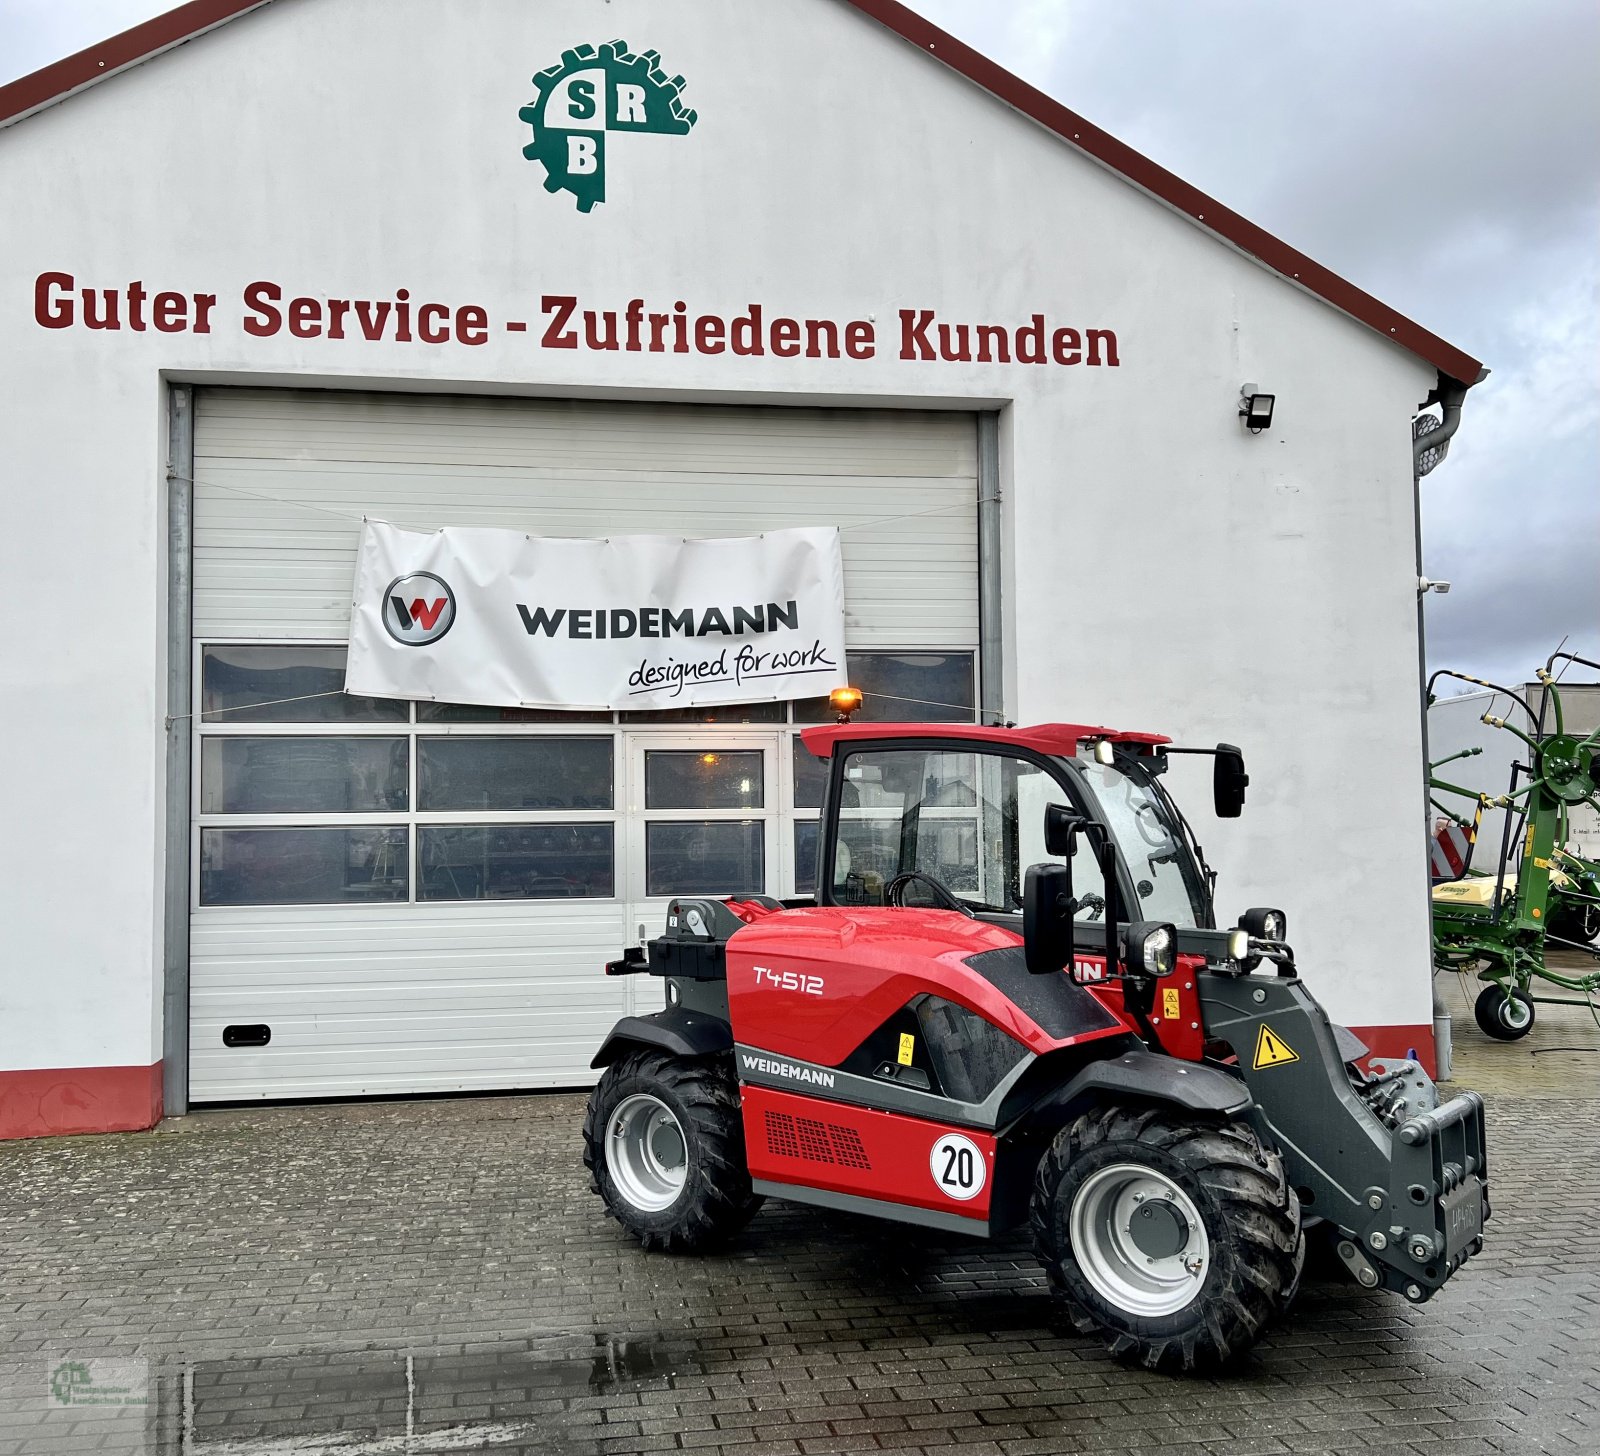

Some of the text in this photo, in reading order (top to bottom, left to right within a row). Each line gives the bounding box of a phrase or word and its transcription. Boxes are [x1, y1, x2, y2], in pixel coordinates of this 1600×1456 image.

[569, 81, 647, 123] S R
[566, 135, 598, 175] B
[35, 272, 216, 333] Guter
[244, 282, 488, 345] Service
[542, 296, 875, 359] Zufriedene
[900, 310, 1119, 366] Kunden
[516, 600, 799, 639] WEIDEMANN
[628, 639, 837, 698] designed for work
[752, 966, 826, 996] T4512
[741, 1054, 836, 1089] WEIDEMANN
[941, 1145, 975, 1189] 20
